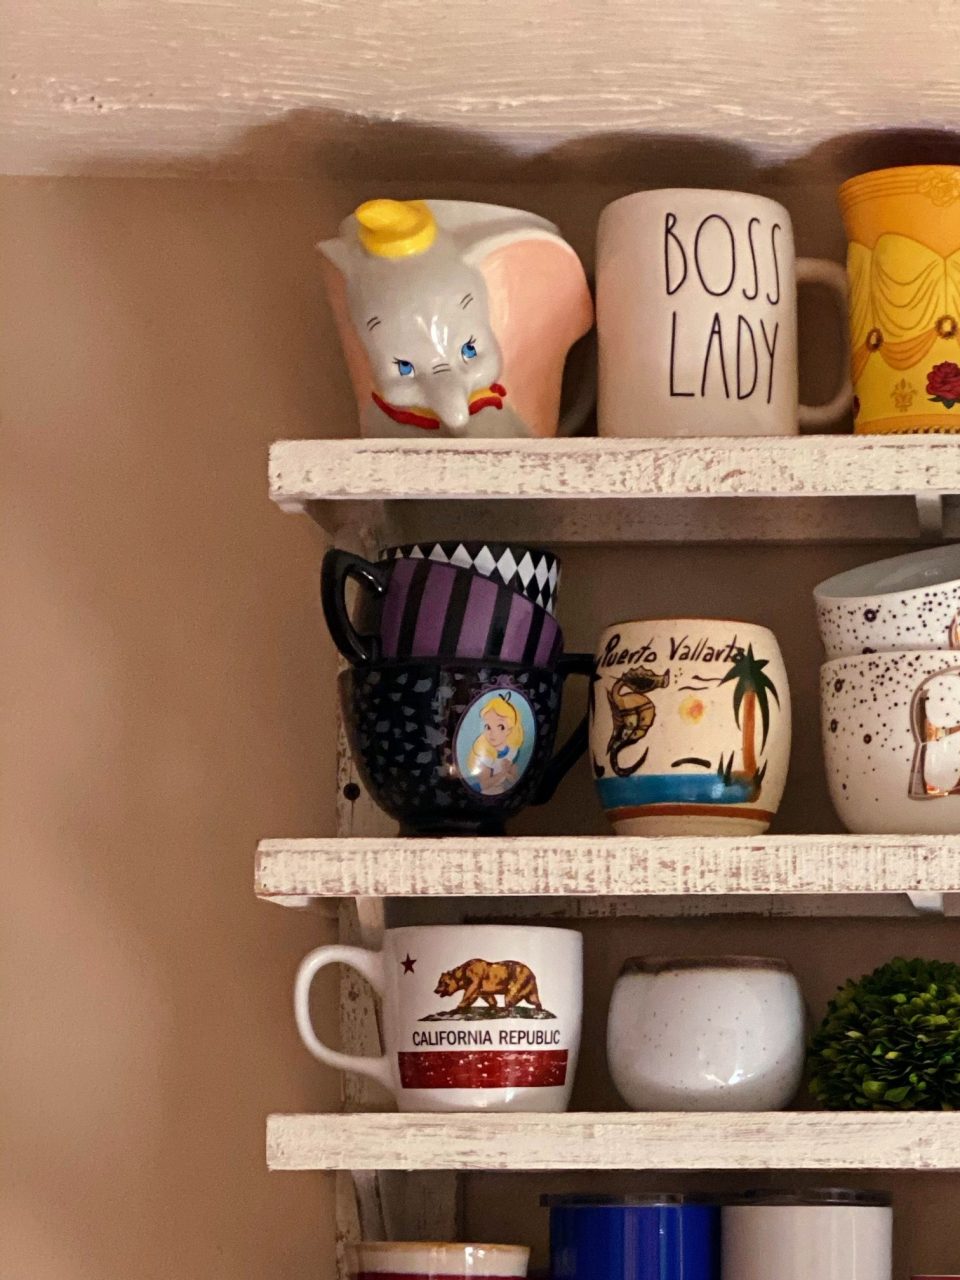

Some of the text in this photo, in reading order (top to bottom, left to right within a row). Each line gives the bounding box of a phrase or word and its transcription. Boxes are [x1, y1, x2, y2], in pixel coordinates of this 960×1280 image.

[664, 212, 782, 306] BOSS
[669, 311, 779, 405] LADY
[602, 633, 746, 667] Puerto Vallarta
[412, 1030, 561, 1046] CALIFORNIA REPUBLIC
